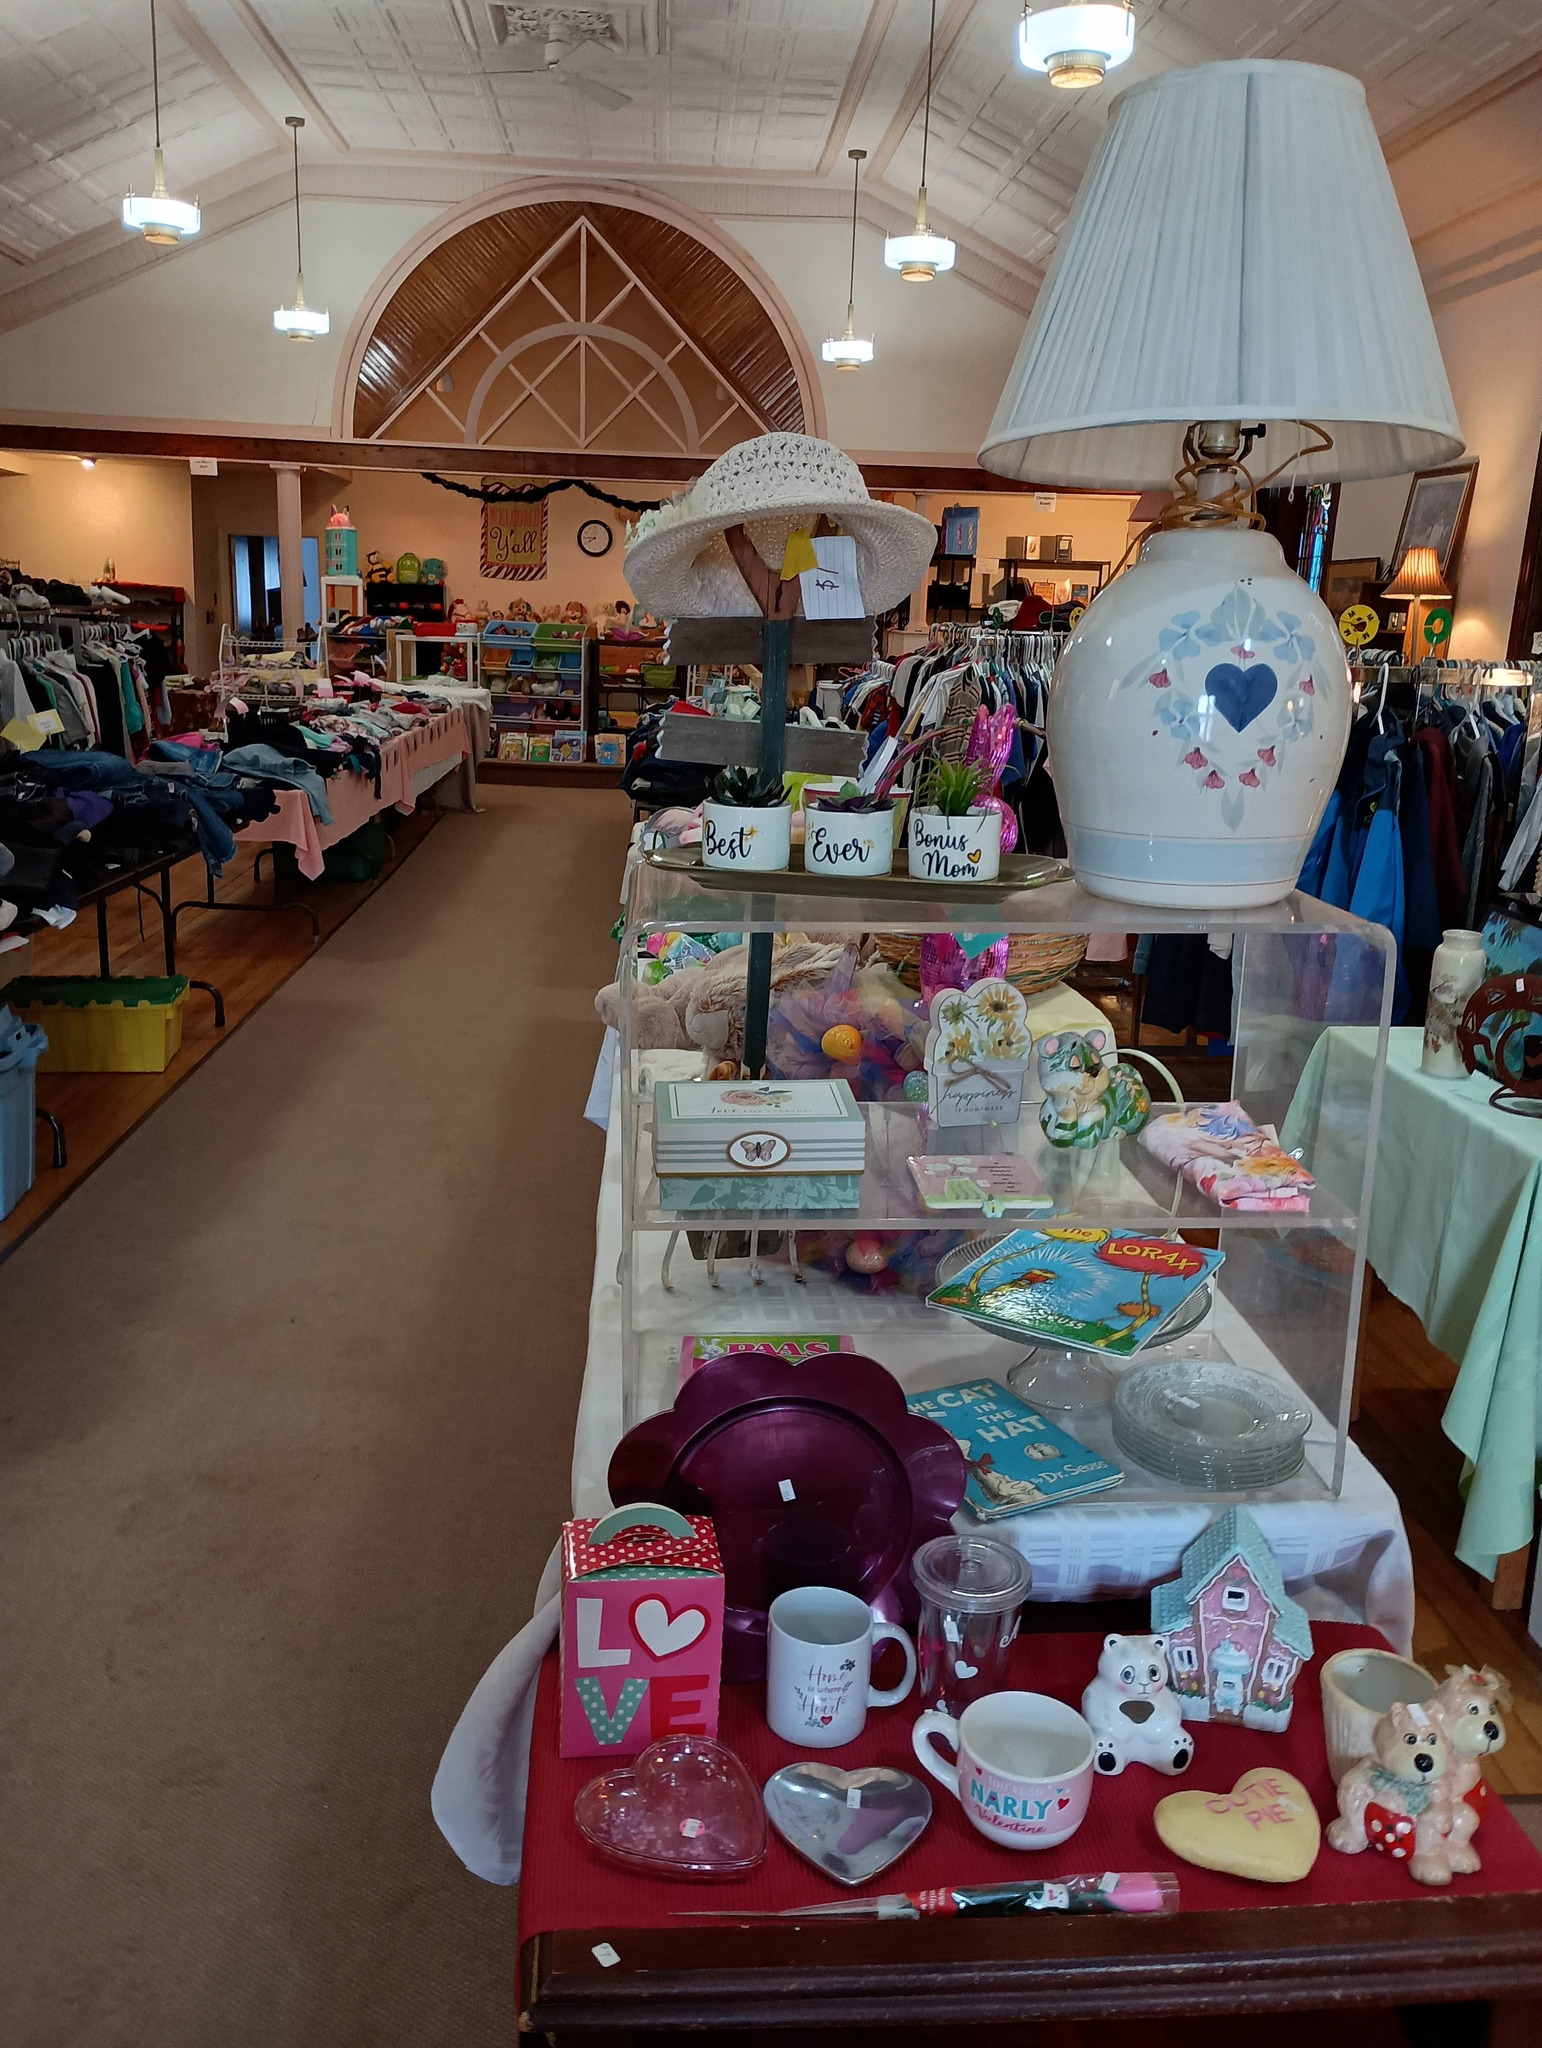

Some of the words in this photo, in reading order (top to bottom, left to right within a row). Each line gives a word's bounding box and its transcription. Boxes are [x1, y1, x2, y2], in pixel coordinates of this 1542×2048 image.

[490, 527, 537, 562] Y'all
[705, 820, 757, 859] Best
[811, 827, 872, 864] Ever
[913, 818, 969, 851] Bonus
[921, 850, 979, 878] Mom
[1107, 1242, 1199, 1271] LORAX
[907, 1400, 938, 1413] HE
[936, 1382, 998, 1408] CAT
[973, 1401, 999, 1413] IN
[975, 1414, 1047, 1443] HAT
[976, 1409, 1018, 1424] THE
[1038, 1471, 1069, 1484] Dr.
[1063, 1460, 1108, 1476] Seuss
[803, 1664, 847, 1687] Home
[800, 1695, 849, 1718] Heart
[970, 1778, 1053, 1820] NARLY
[1205, 1777, 1290, 1814] CUTIE
[974, 1804, 1047, 1835] Valentine
[1244, 1803, 1296, 1831] PIE
